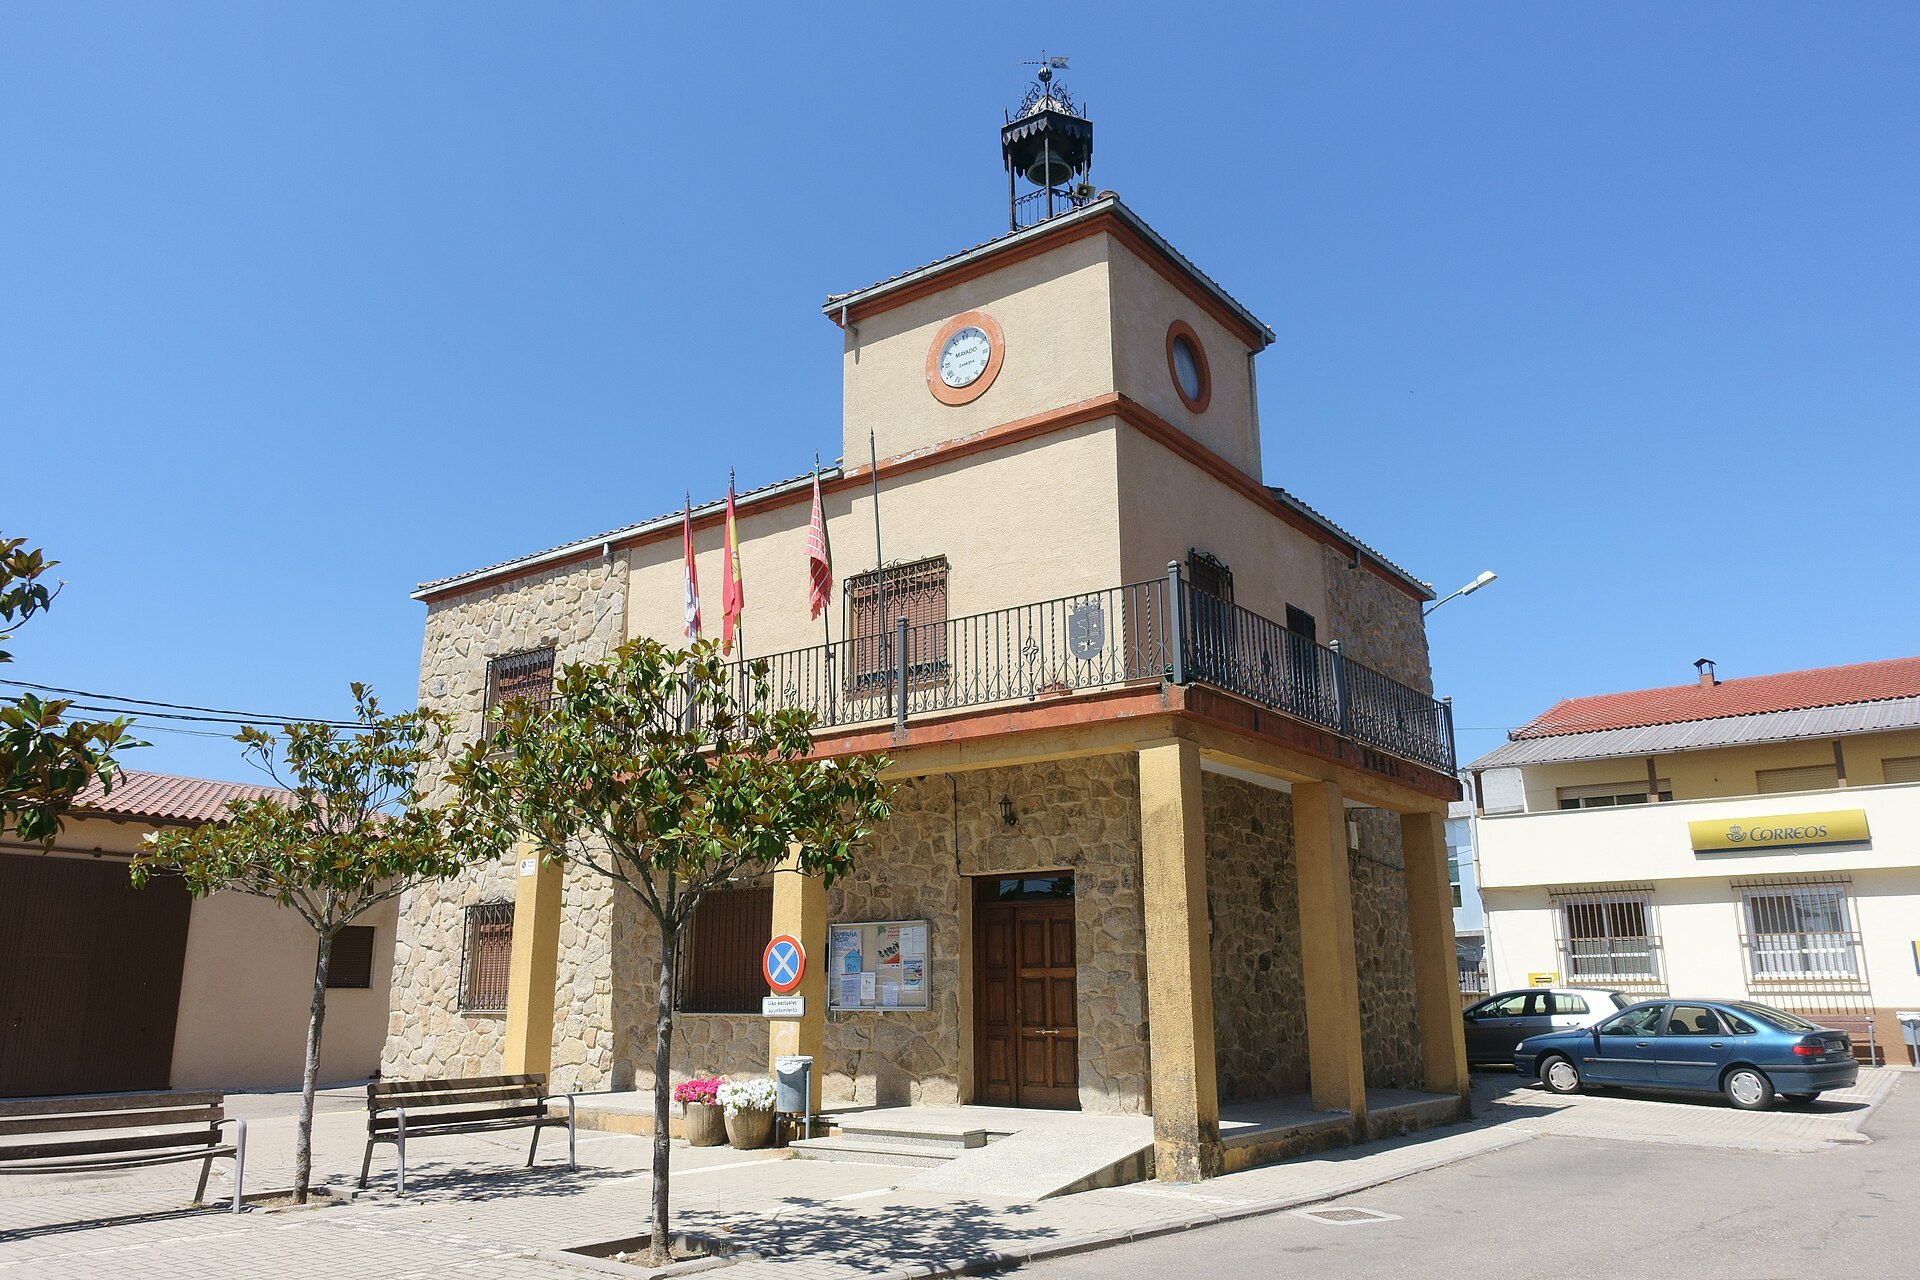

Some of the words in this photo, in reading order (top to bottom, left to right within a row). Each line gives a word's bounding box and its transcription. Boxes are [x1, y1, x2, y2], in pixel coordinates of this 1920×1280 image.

[1750, 825, 1827, 841] CORREOS
[834, 930, 858, 938] CAMPAÑA
[847, 963, 857, 971] Rn
